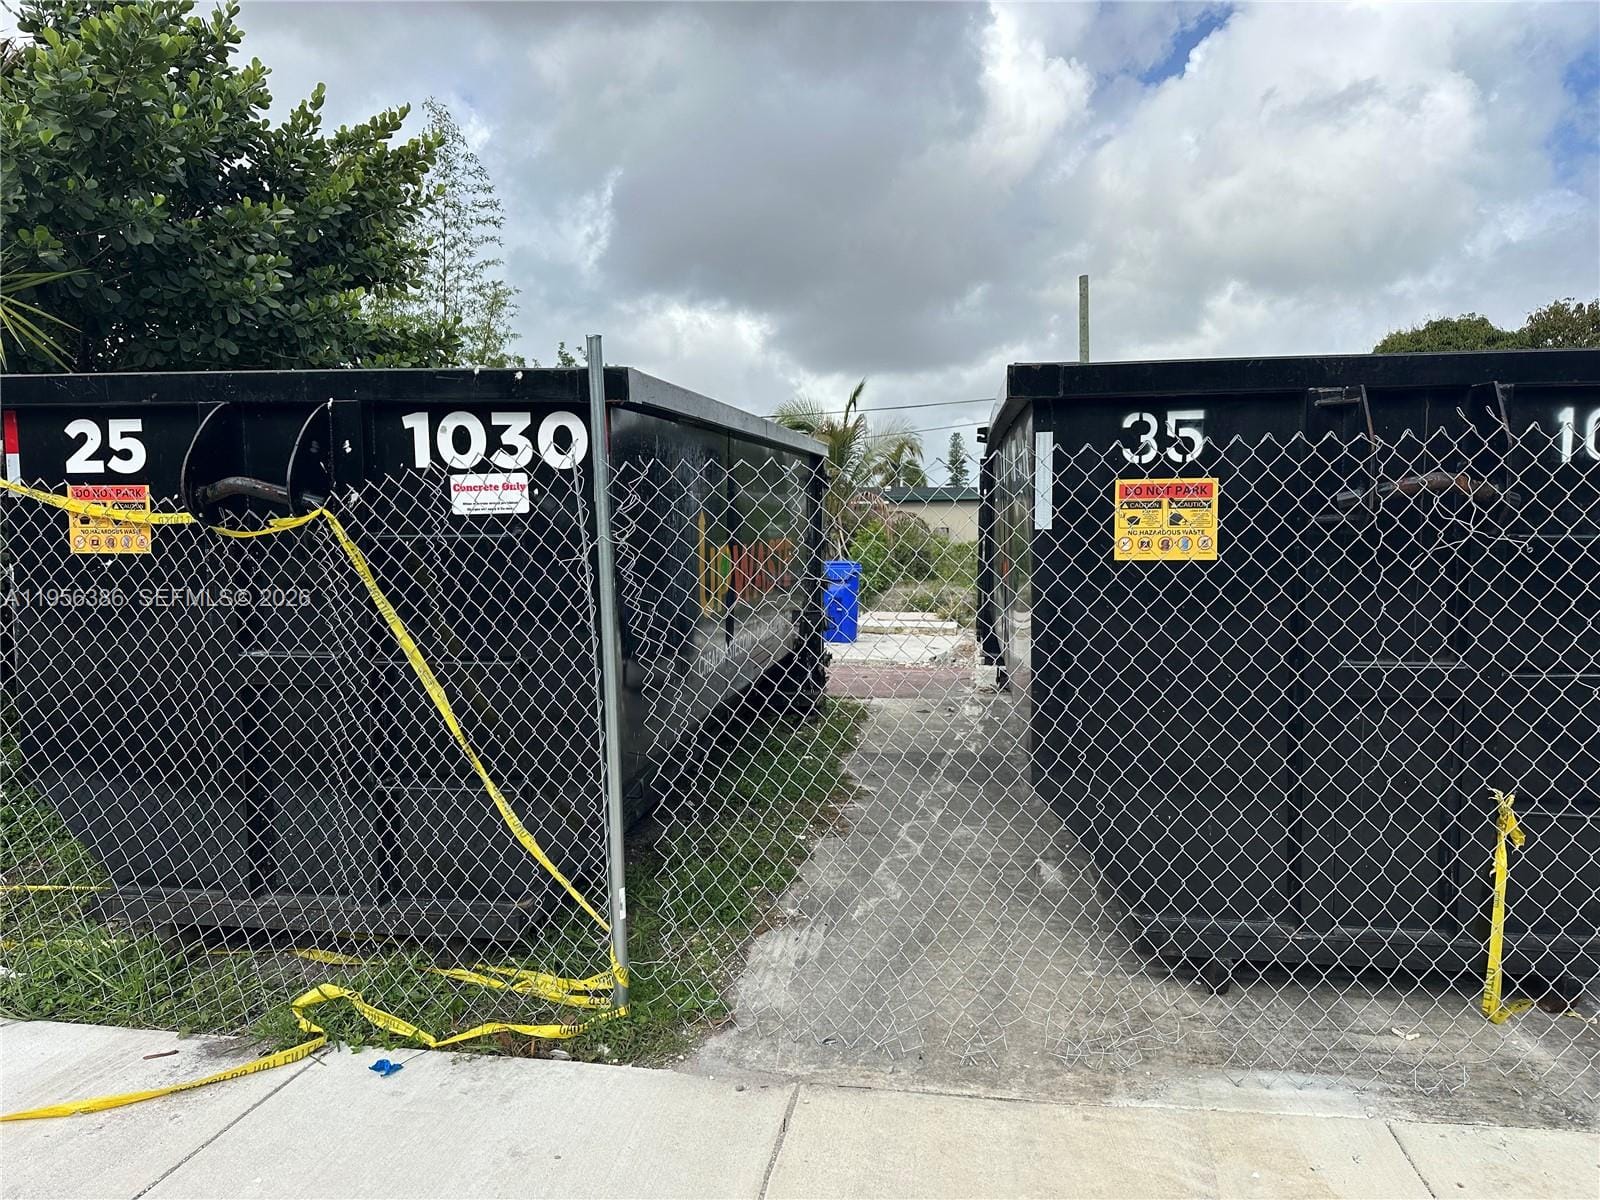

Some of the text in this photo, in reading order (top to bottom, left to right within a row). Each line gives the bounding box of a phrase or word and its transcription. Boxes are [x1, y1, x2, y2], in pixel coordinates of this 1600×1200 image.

[64, 419, 147, 474] 25
[402, 411, 588, 470] 1030
[1122, 410, 1205, 464] 35
[76, 489, 91, 498] DO
[116, 488, 142, 497] PARK
[453, 482, 526, 492] Concrete Only
[1125, 486, 1208, 496] DO NOT PARK
